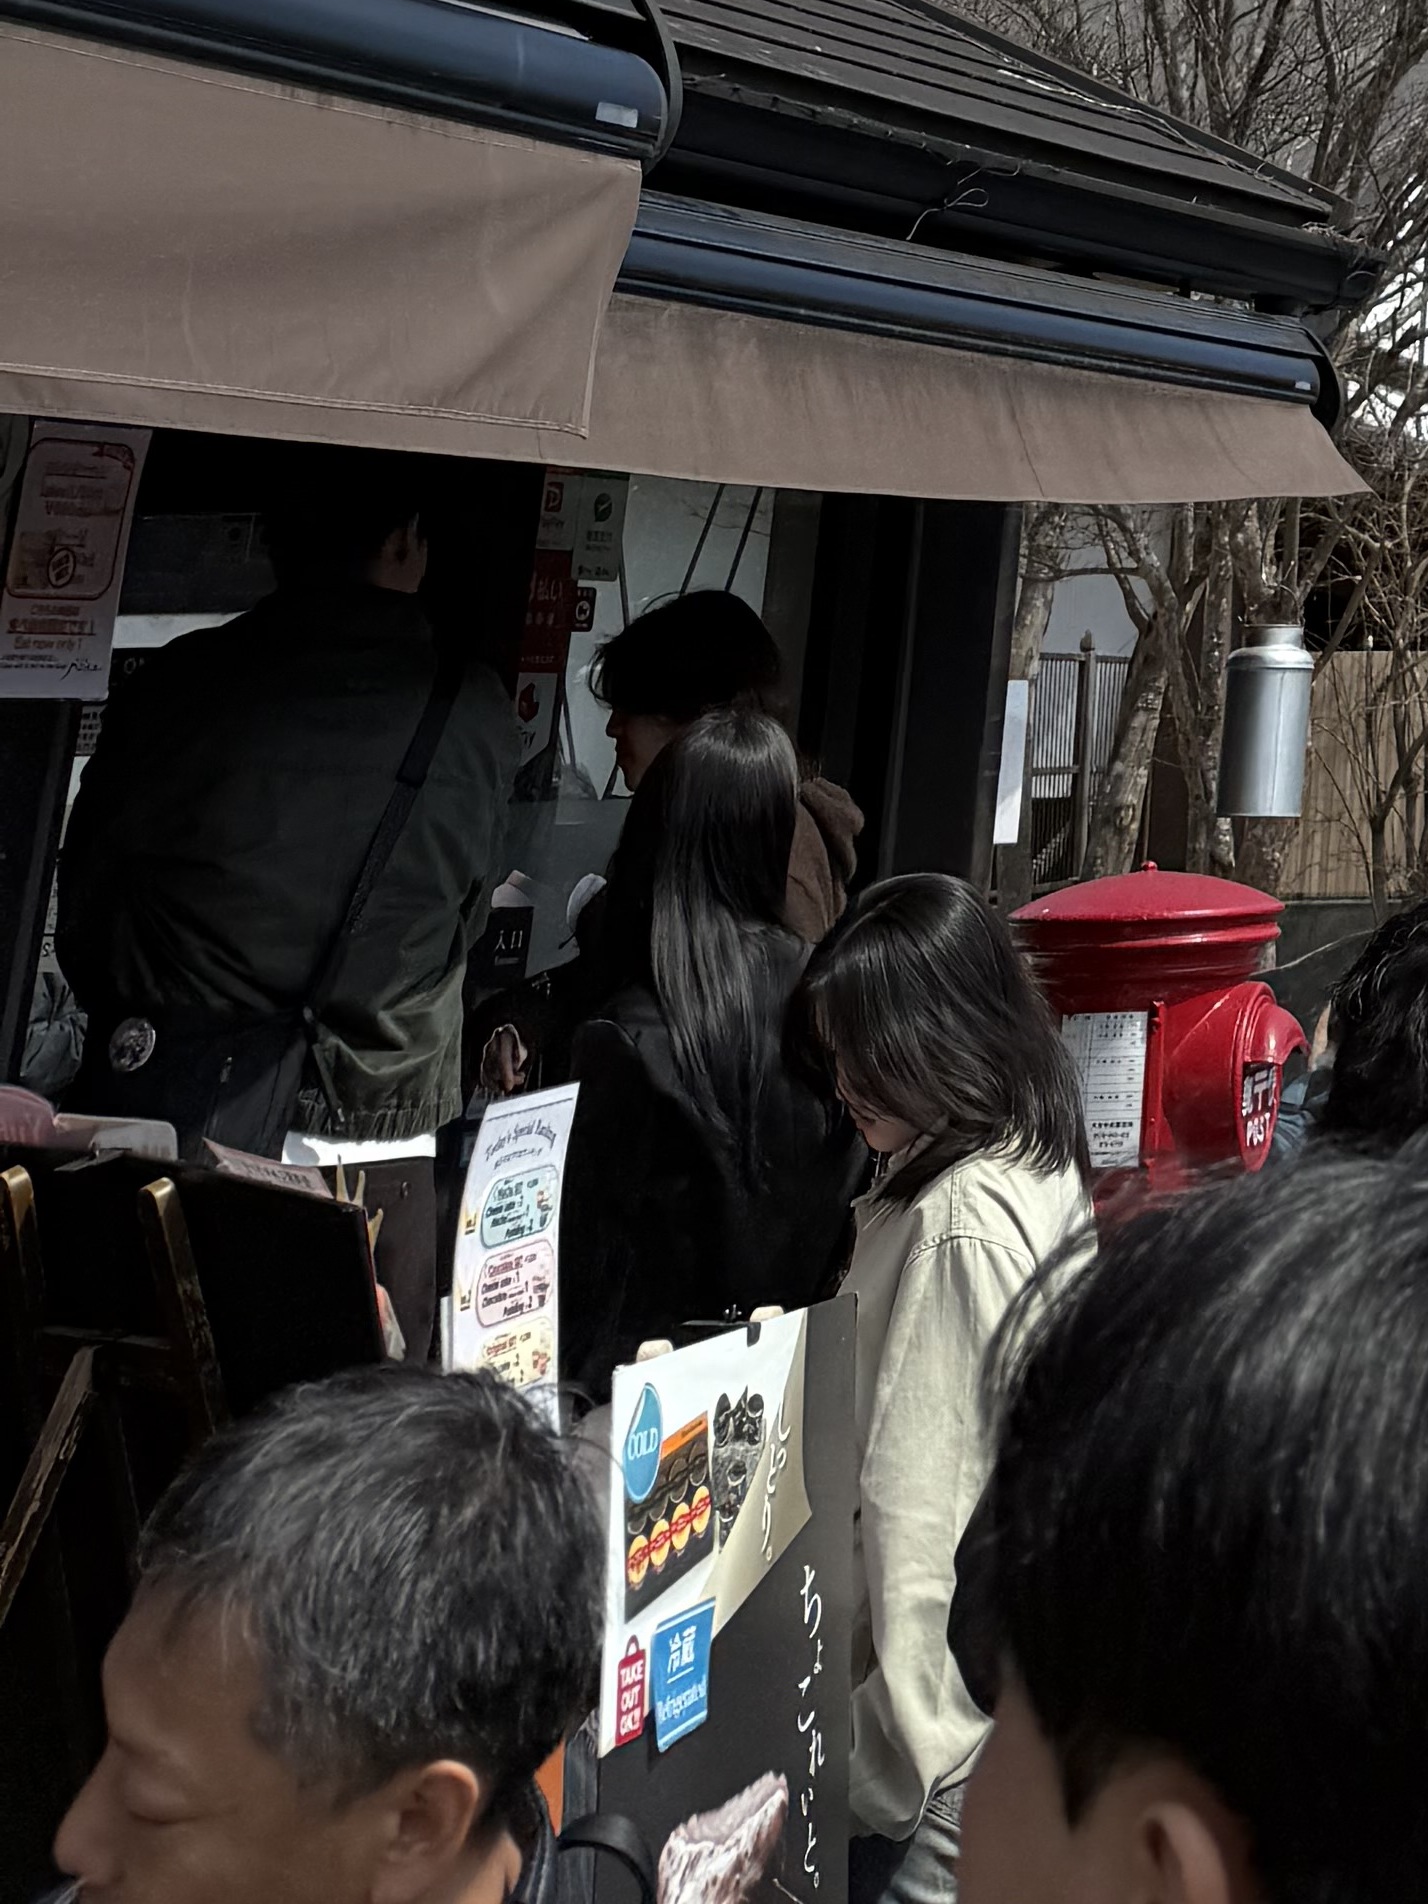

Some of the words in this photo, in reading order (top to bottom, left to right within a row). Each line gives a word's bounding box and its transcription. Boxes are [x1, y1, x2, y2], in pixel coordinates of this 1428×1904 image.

[493, 929, 523, 952] 入口
[1246, 1111, 1272, 1148] POST
[627, 1429, 659, 1462] COLD
[667, 1624, 696, 1674] 冷蔵
[620, 1659, 644, 1689] TAKE
[621, 1684, 641, 1712] OUT
